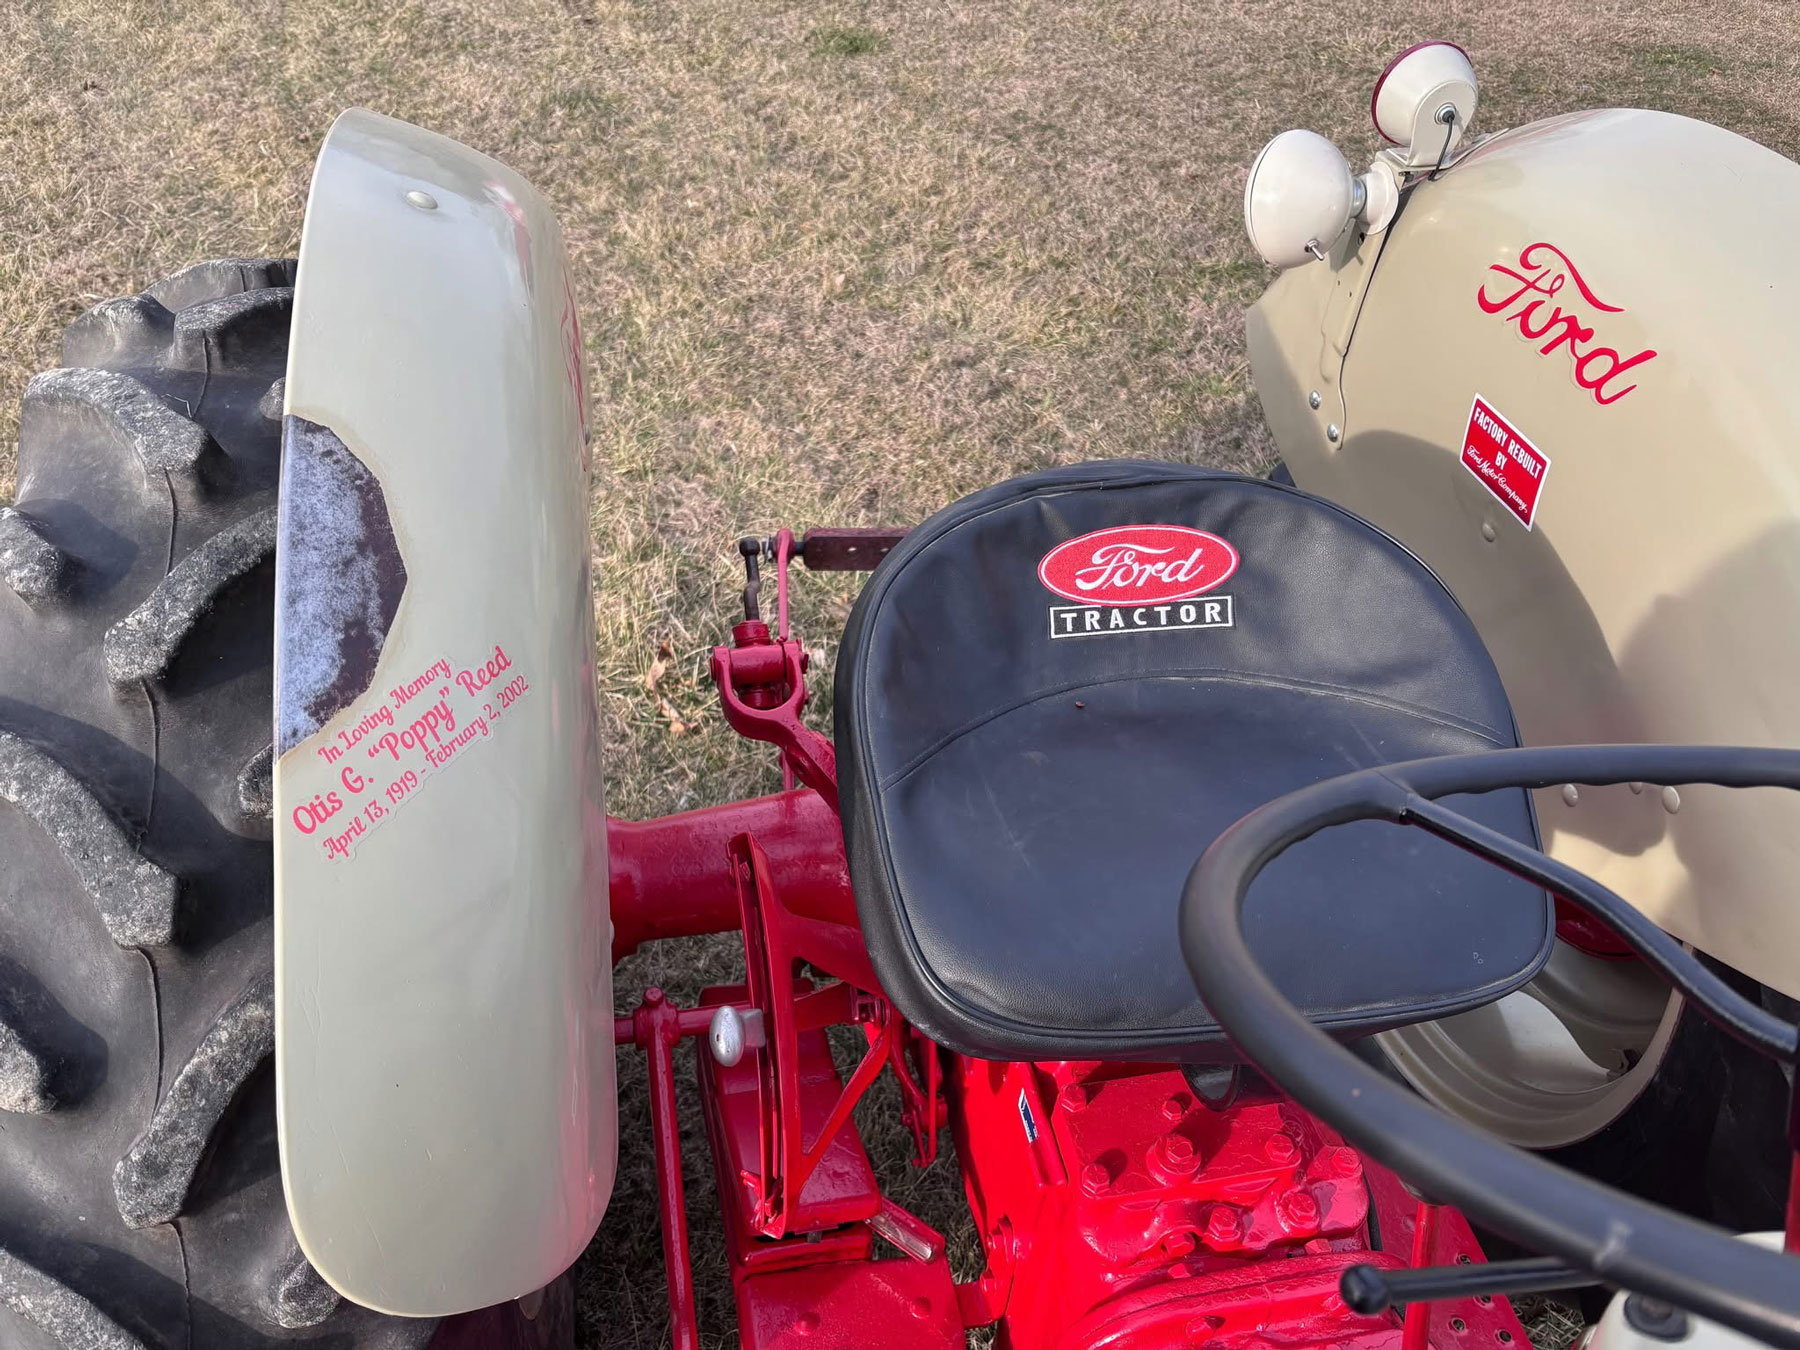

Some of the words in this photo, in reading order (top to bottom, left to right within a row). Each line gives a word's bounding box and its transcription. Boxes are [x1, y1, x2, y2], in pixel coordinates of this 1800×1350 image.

[1478, 242, 1657, 405] Ford
[1467, 445, 1483, 466] Ford
[1478, 460, 1500, 480] Motor
[1473, 407, 1508, 447] FACTORY
[1507, 439, 1542, 479] REBUILT
[1495, 451, 1507, 470] BY
[1075, 543, 1205, 590] Ford
[1060, 602, 1222, 632] TRACTOR
[293, 791, 343, 835] Otis
[341, 766, 374, 794] G.
[456, 645, 512, 697] Reed
[318, 746, 343, 764] In
[338, 705, 394, 750] Loving
[390, 658, 452, 709] Memory
[323, 816, 367, 860] April
[364, 799, 390, 823] 13,
[386, 770, 418, 804] 1919
[425, 716, 489, 768] February
[483, 703, 501, 720] 2,
[496, 675, 529, 709] 2002
